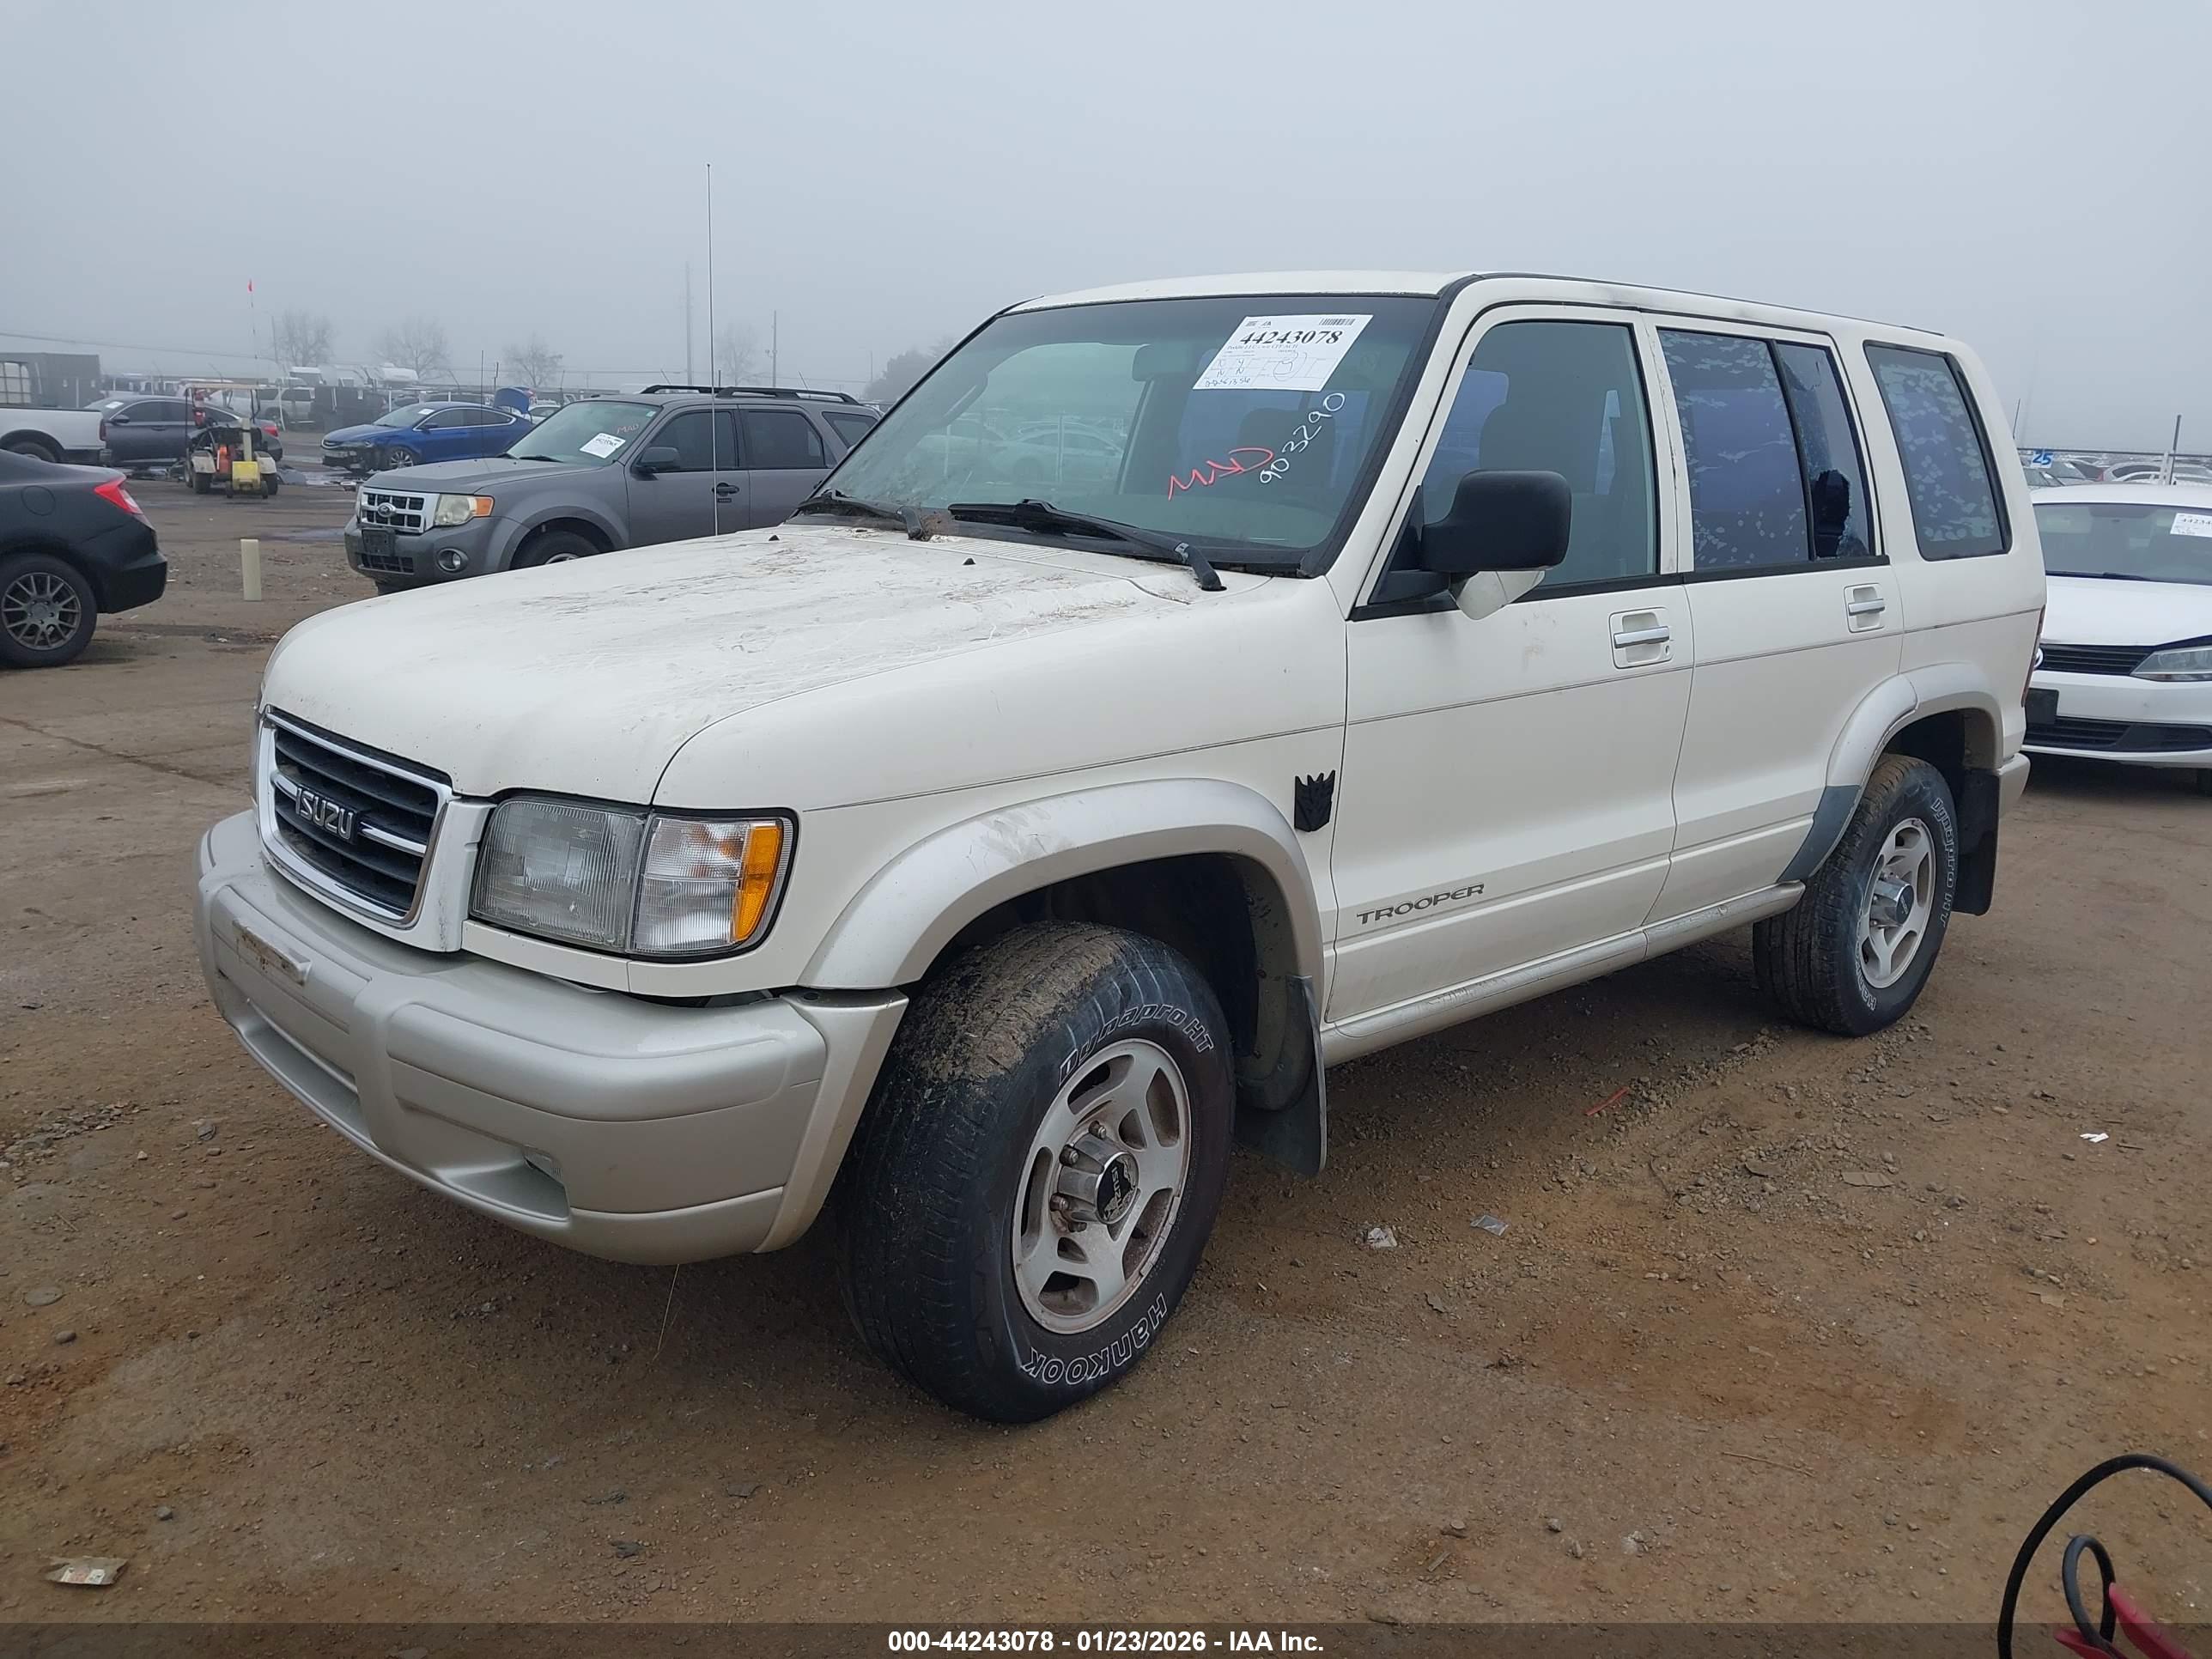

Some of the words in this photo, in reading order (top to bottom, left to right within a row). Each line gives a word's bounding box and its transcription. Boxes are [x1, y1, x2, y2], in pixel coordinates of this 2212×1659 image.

[1241, 331, 1343, 344] 44243078
[1259, 392, 1346, 483] 903290
[2033, 448, 2053, 465] 25
[295, 787, 354, 840] ISUZU
[1356, 883, 1485, 926] TROOPER
[1058, 1003, 1188, 1087] Dynapro
[1182, 1018, 1215, 1054] HT
[1019, 1291, 1169, 1385] Hankook
